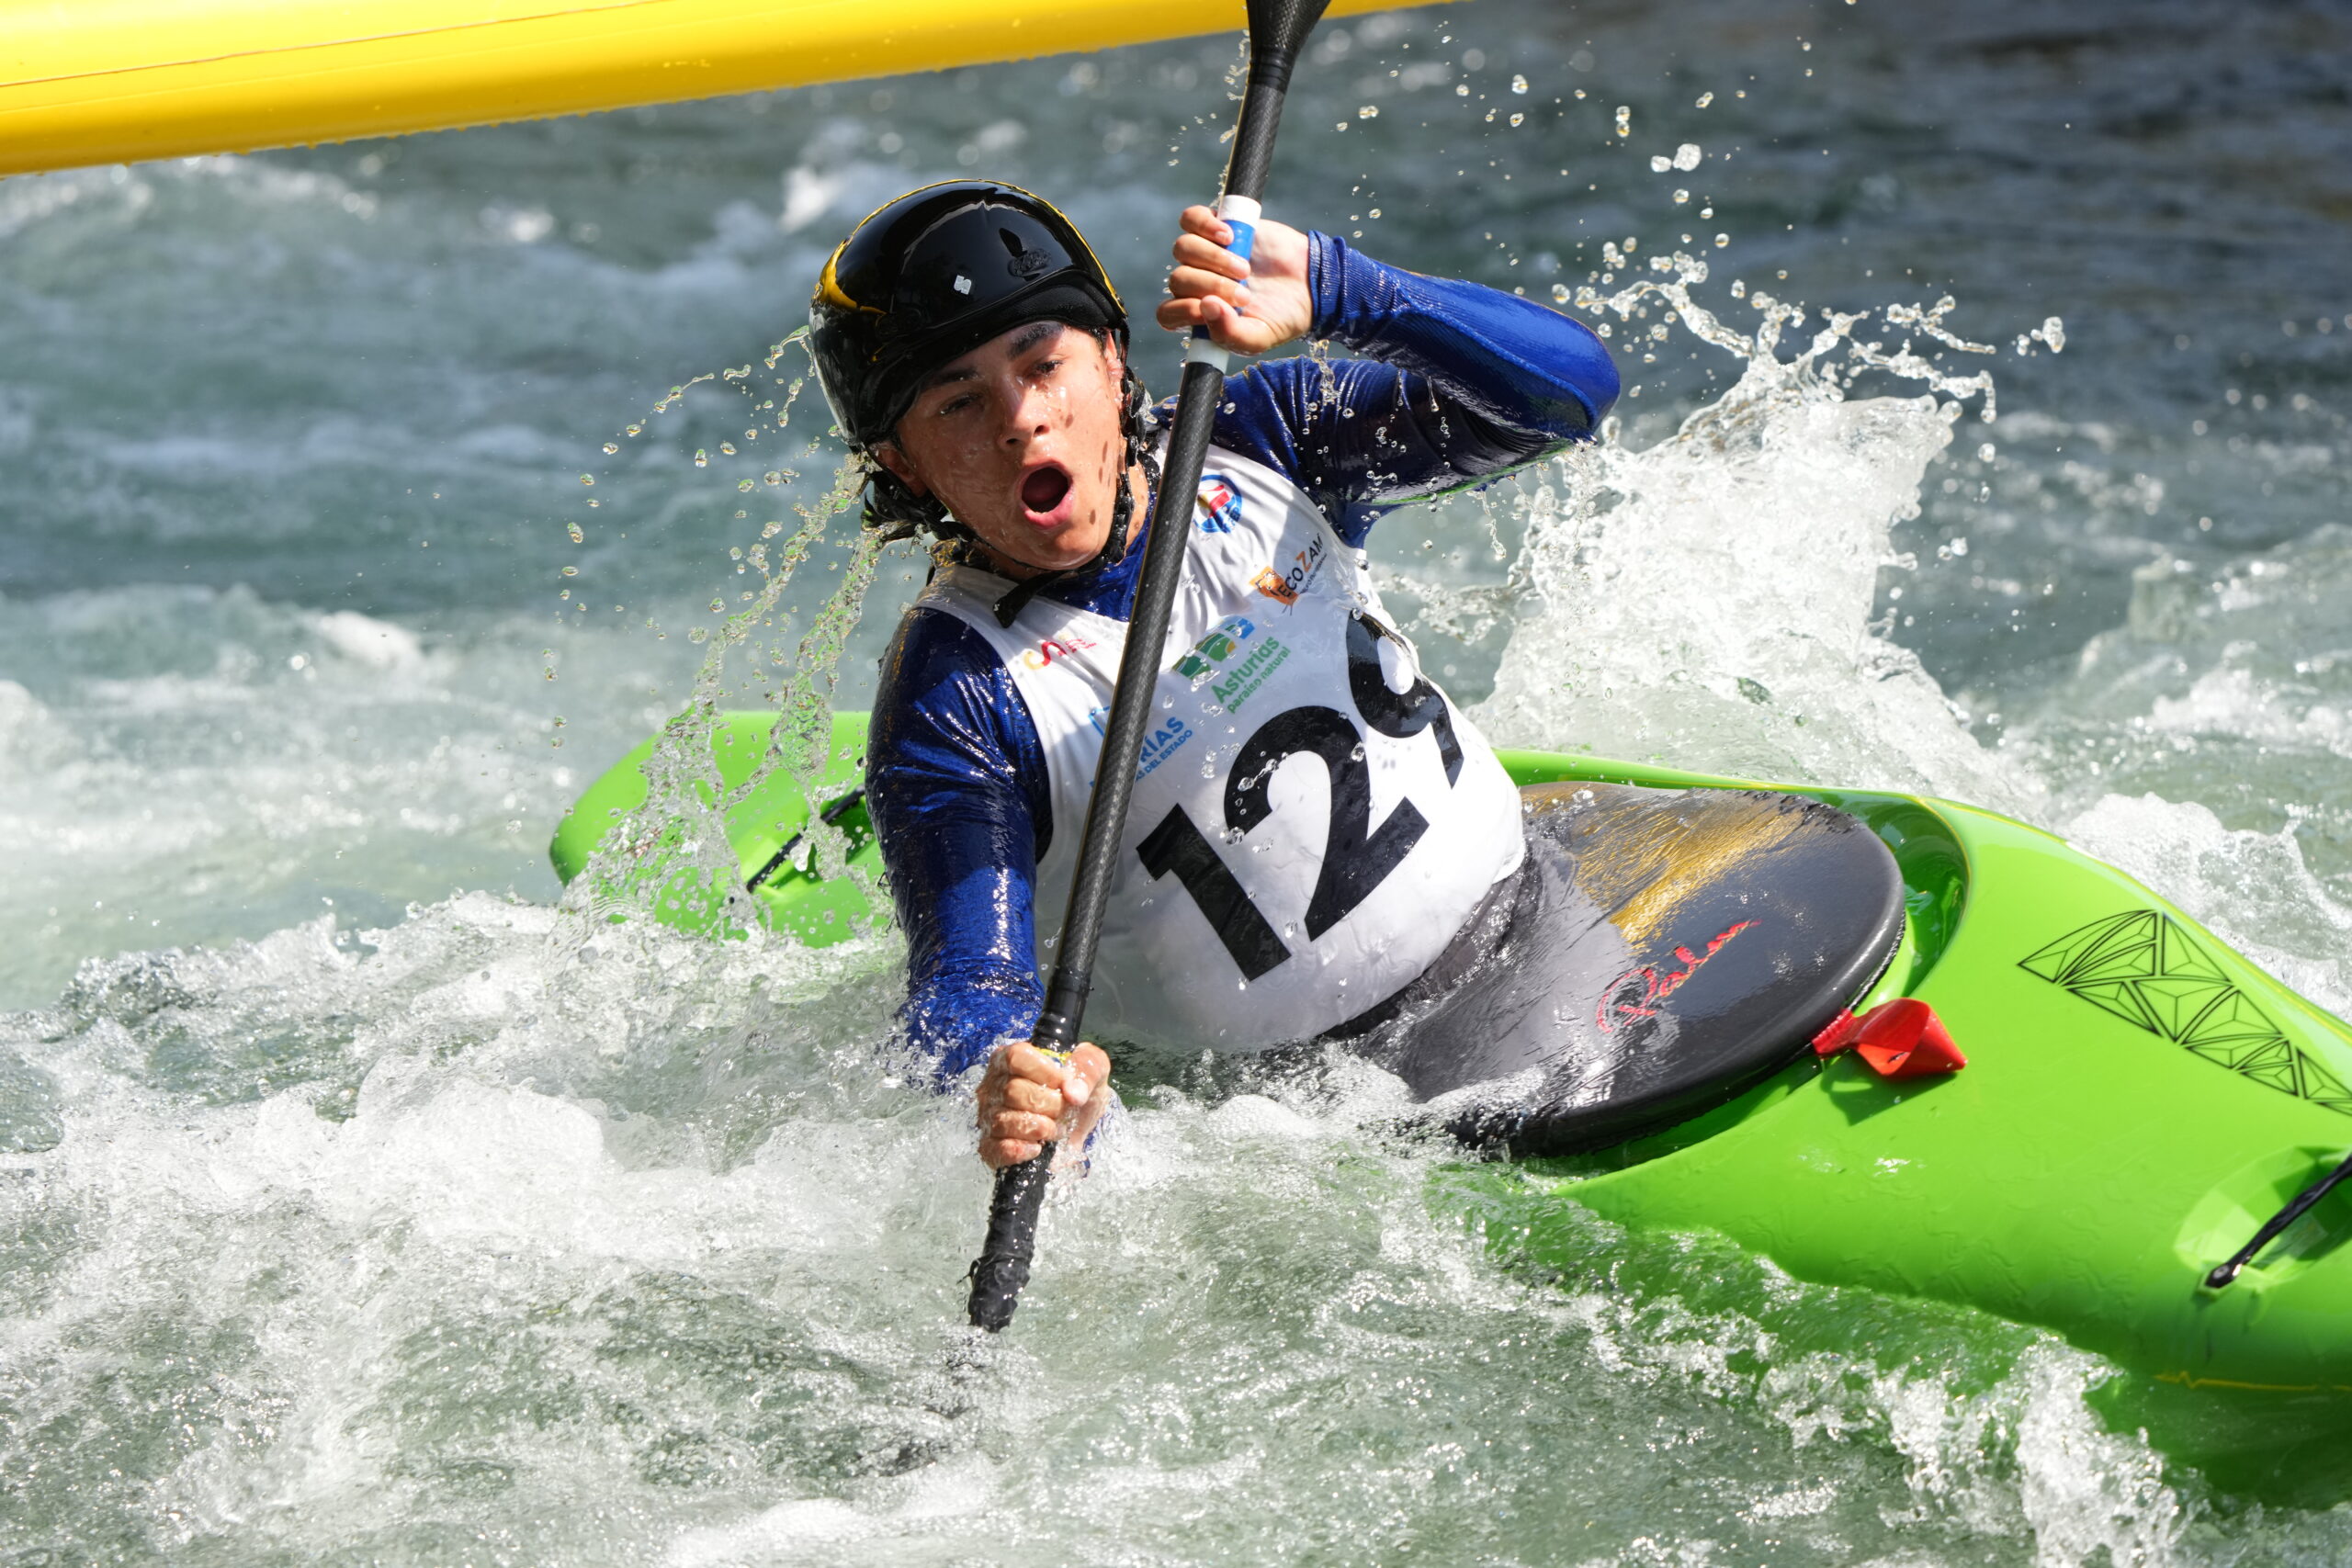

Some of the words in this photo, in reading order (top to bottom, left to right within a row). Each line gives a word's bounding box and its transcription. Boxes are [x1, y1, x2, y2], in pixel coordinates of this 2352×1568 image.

[1278, 533, 1324, 597] ECOZAM
[1211, 636, 1280, 705] Asturias
[1260, 646, 1291, 680] natural
[1144, 759, 1161, 773] DEL
[1159, 729, 1193, 761] ESTADO
[1136, 610, 1464, 982] 129
